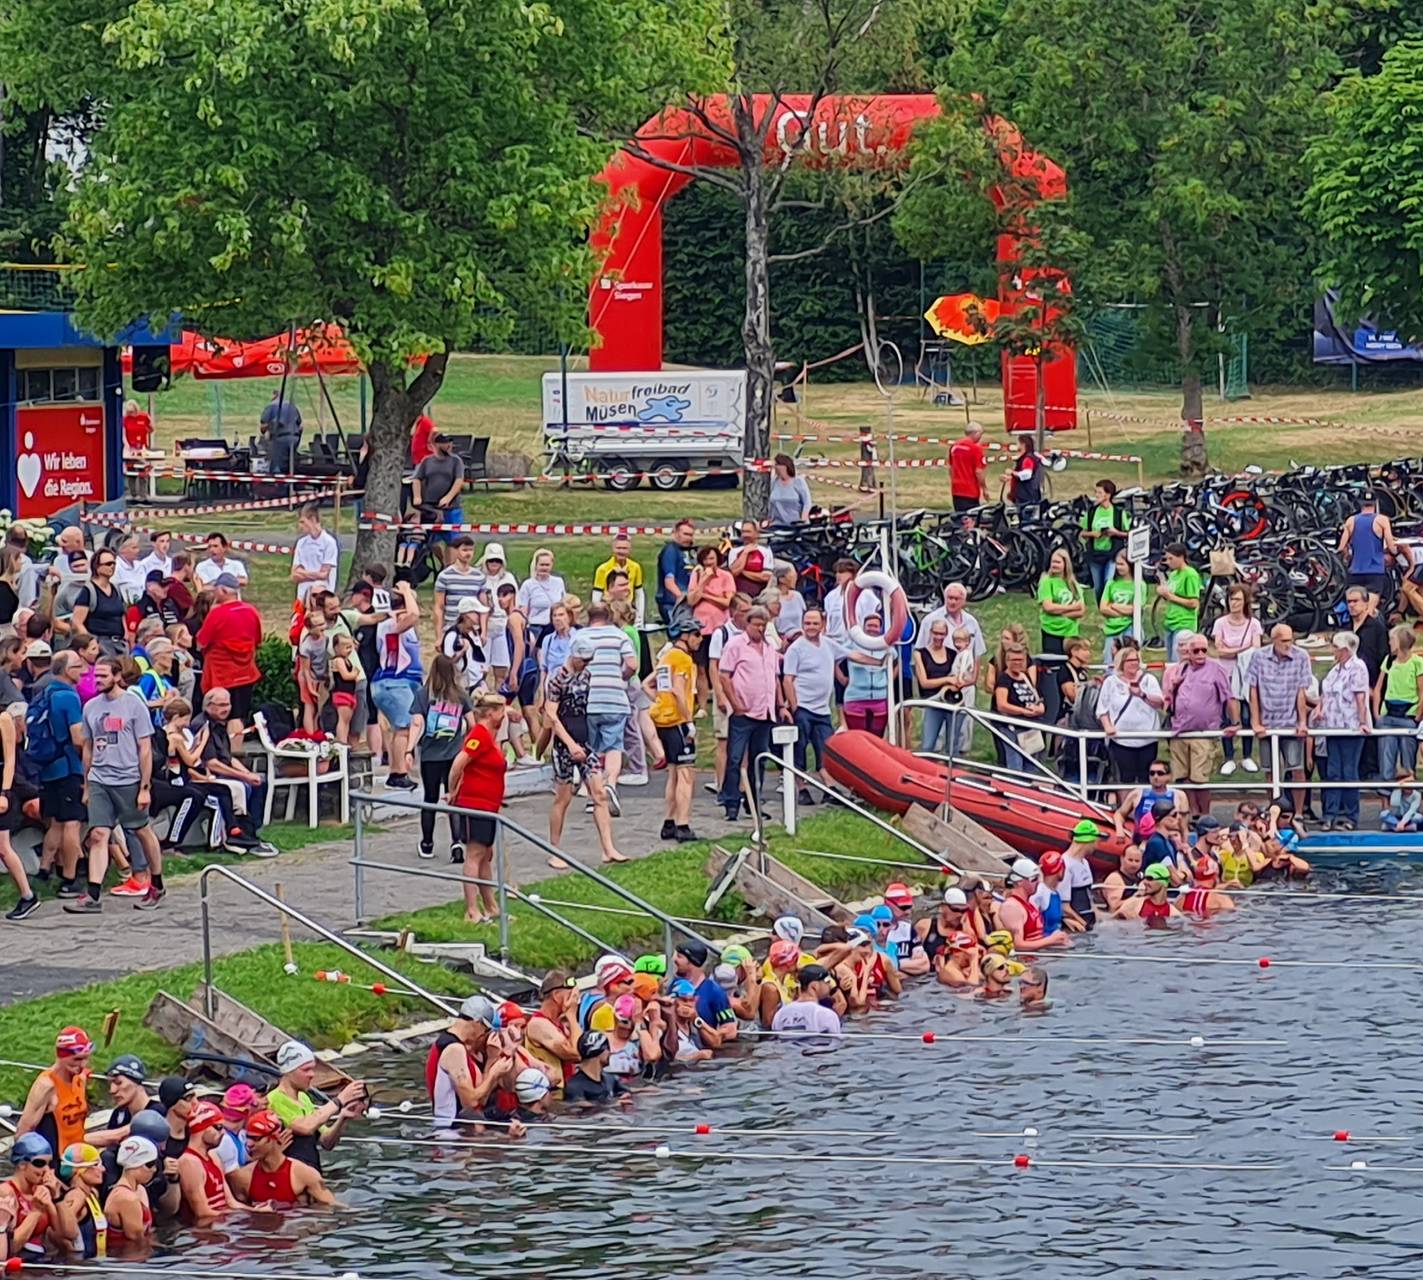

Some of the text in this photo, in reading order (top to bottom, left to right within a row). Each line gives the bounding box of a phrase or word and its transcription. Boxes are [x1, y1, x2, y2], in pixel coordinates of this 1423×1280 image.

[585, 405, 637, 421] Müsen
[44, 452, 86, 470] Wir leben
